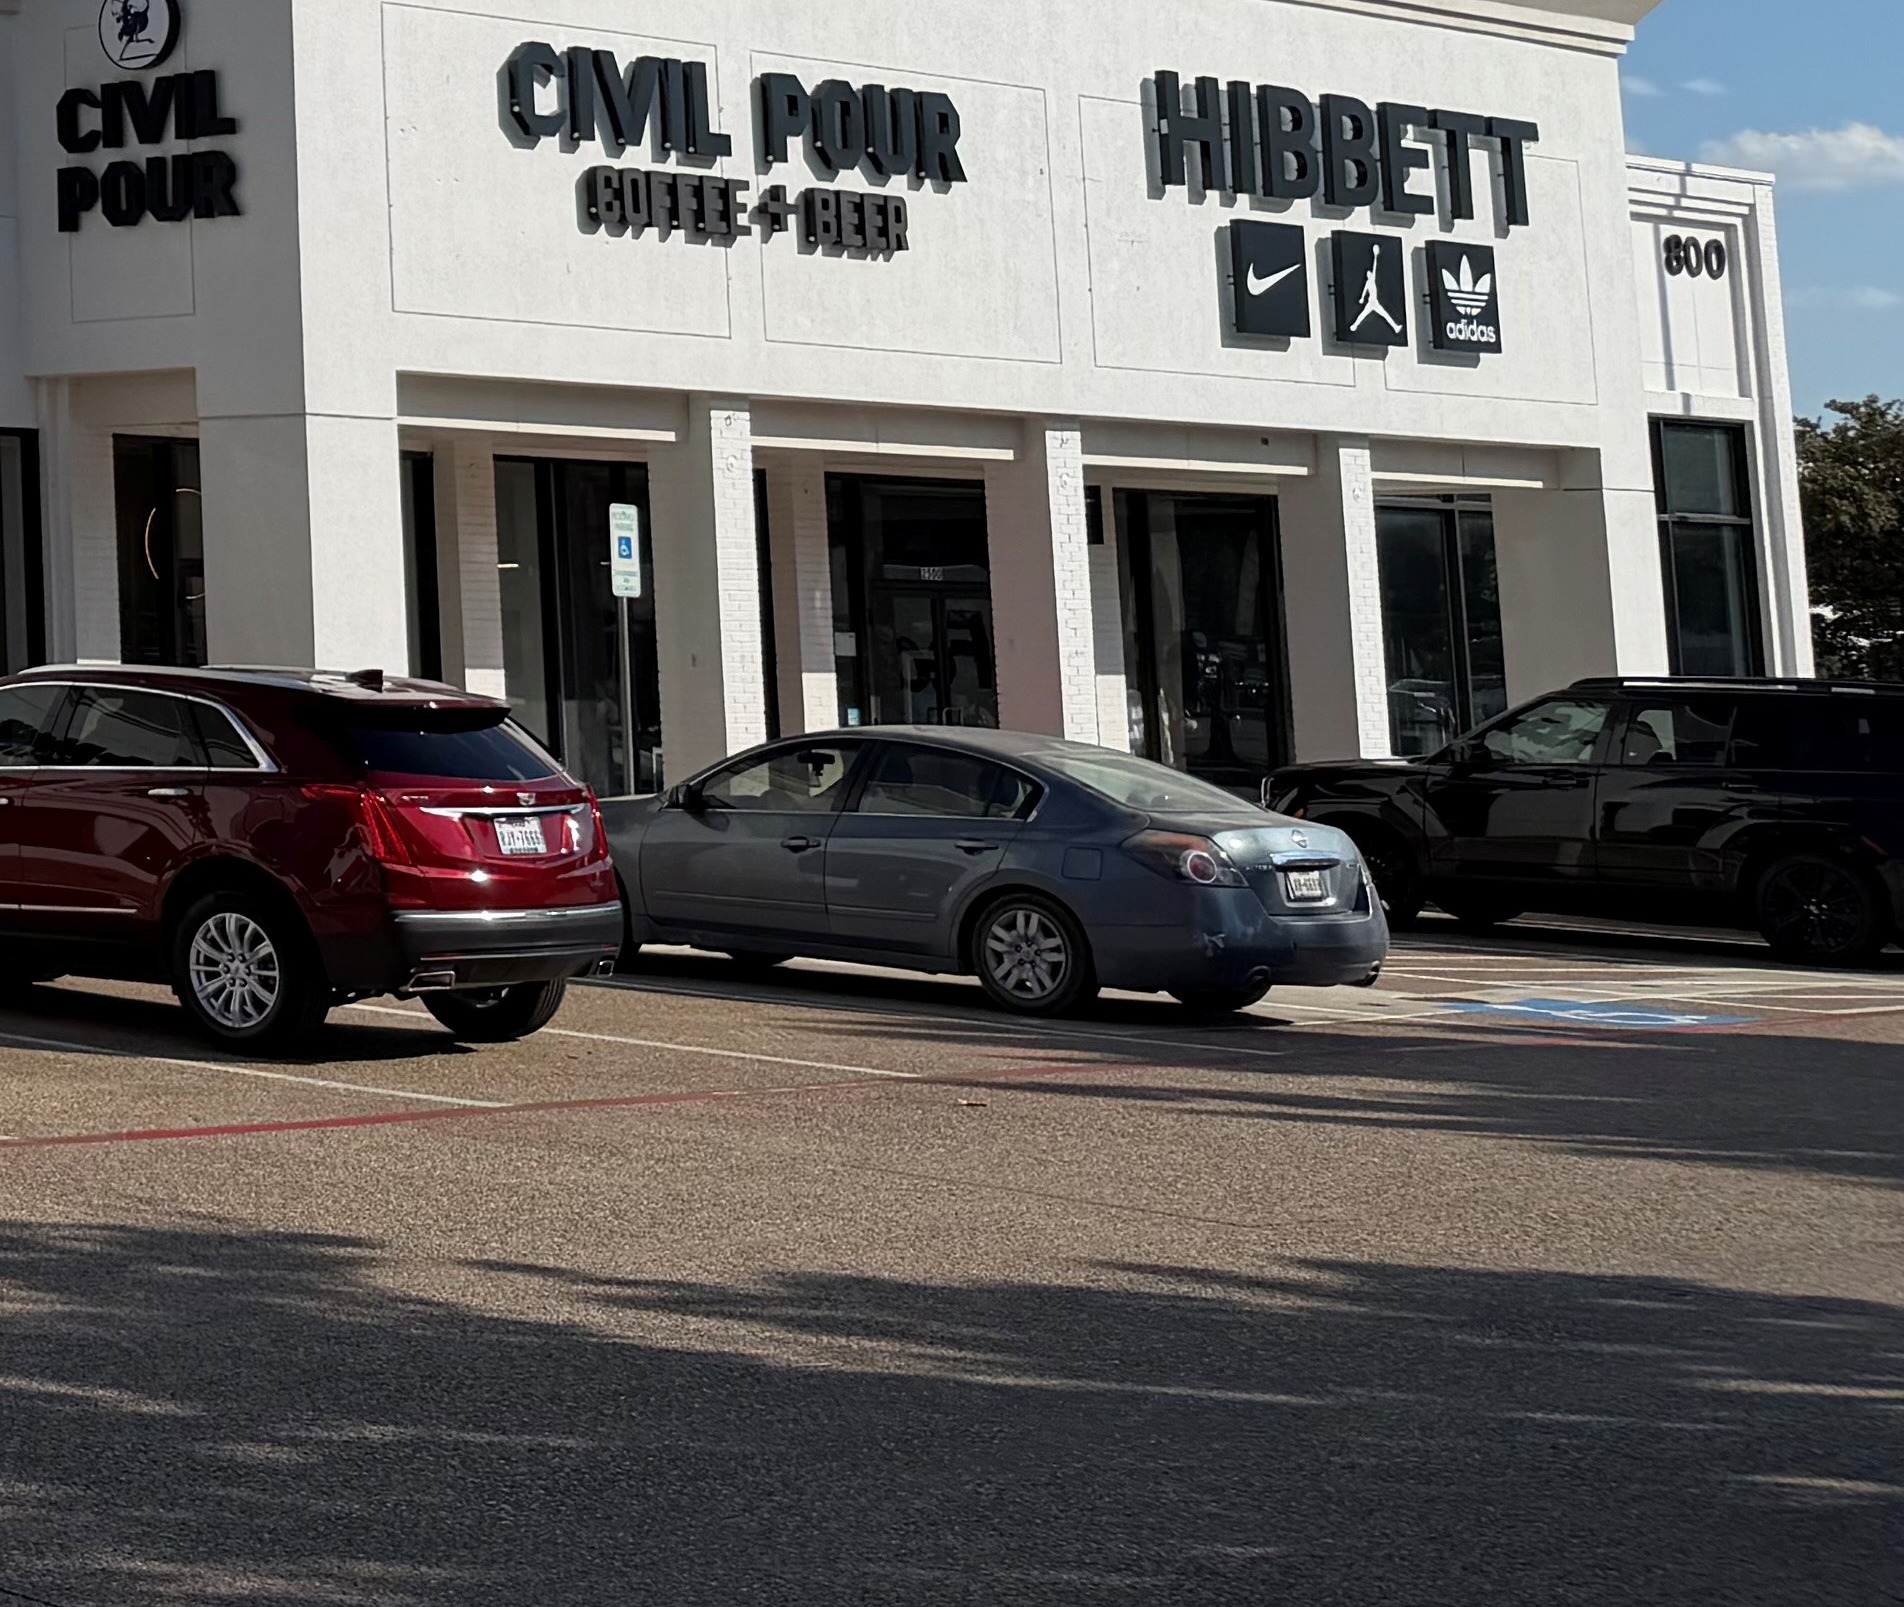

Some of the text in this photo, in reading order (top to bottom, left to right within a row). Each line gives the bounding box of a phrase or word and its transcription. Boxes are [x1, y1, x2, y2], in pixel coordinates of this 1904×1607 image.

[56, 69, 237, 154] CIVIL
[508, 41, 967, 182] CIVIL POUR
[1154, 70, 1540, 227] HIBBETT
[56, 150, 243, 233] POUR
[589, 165, 753, 237] COFFEE
[800, 187, 910, 252] BEER
[1663, 234, 1726, 281] 800
[1445, 318, 1497, 343] adidas
